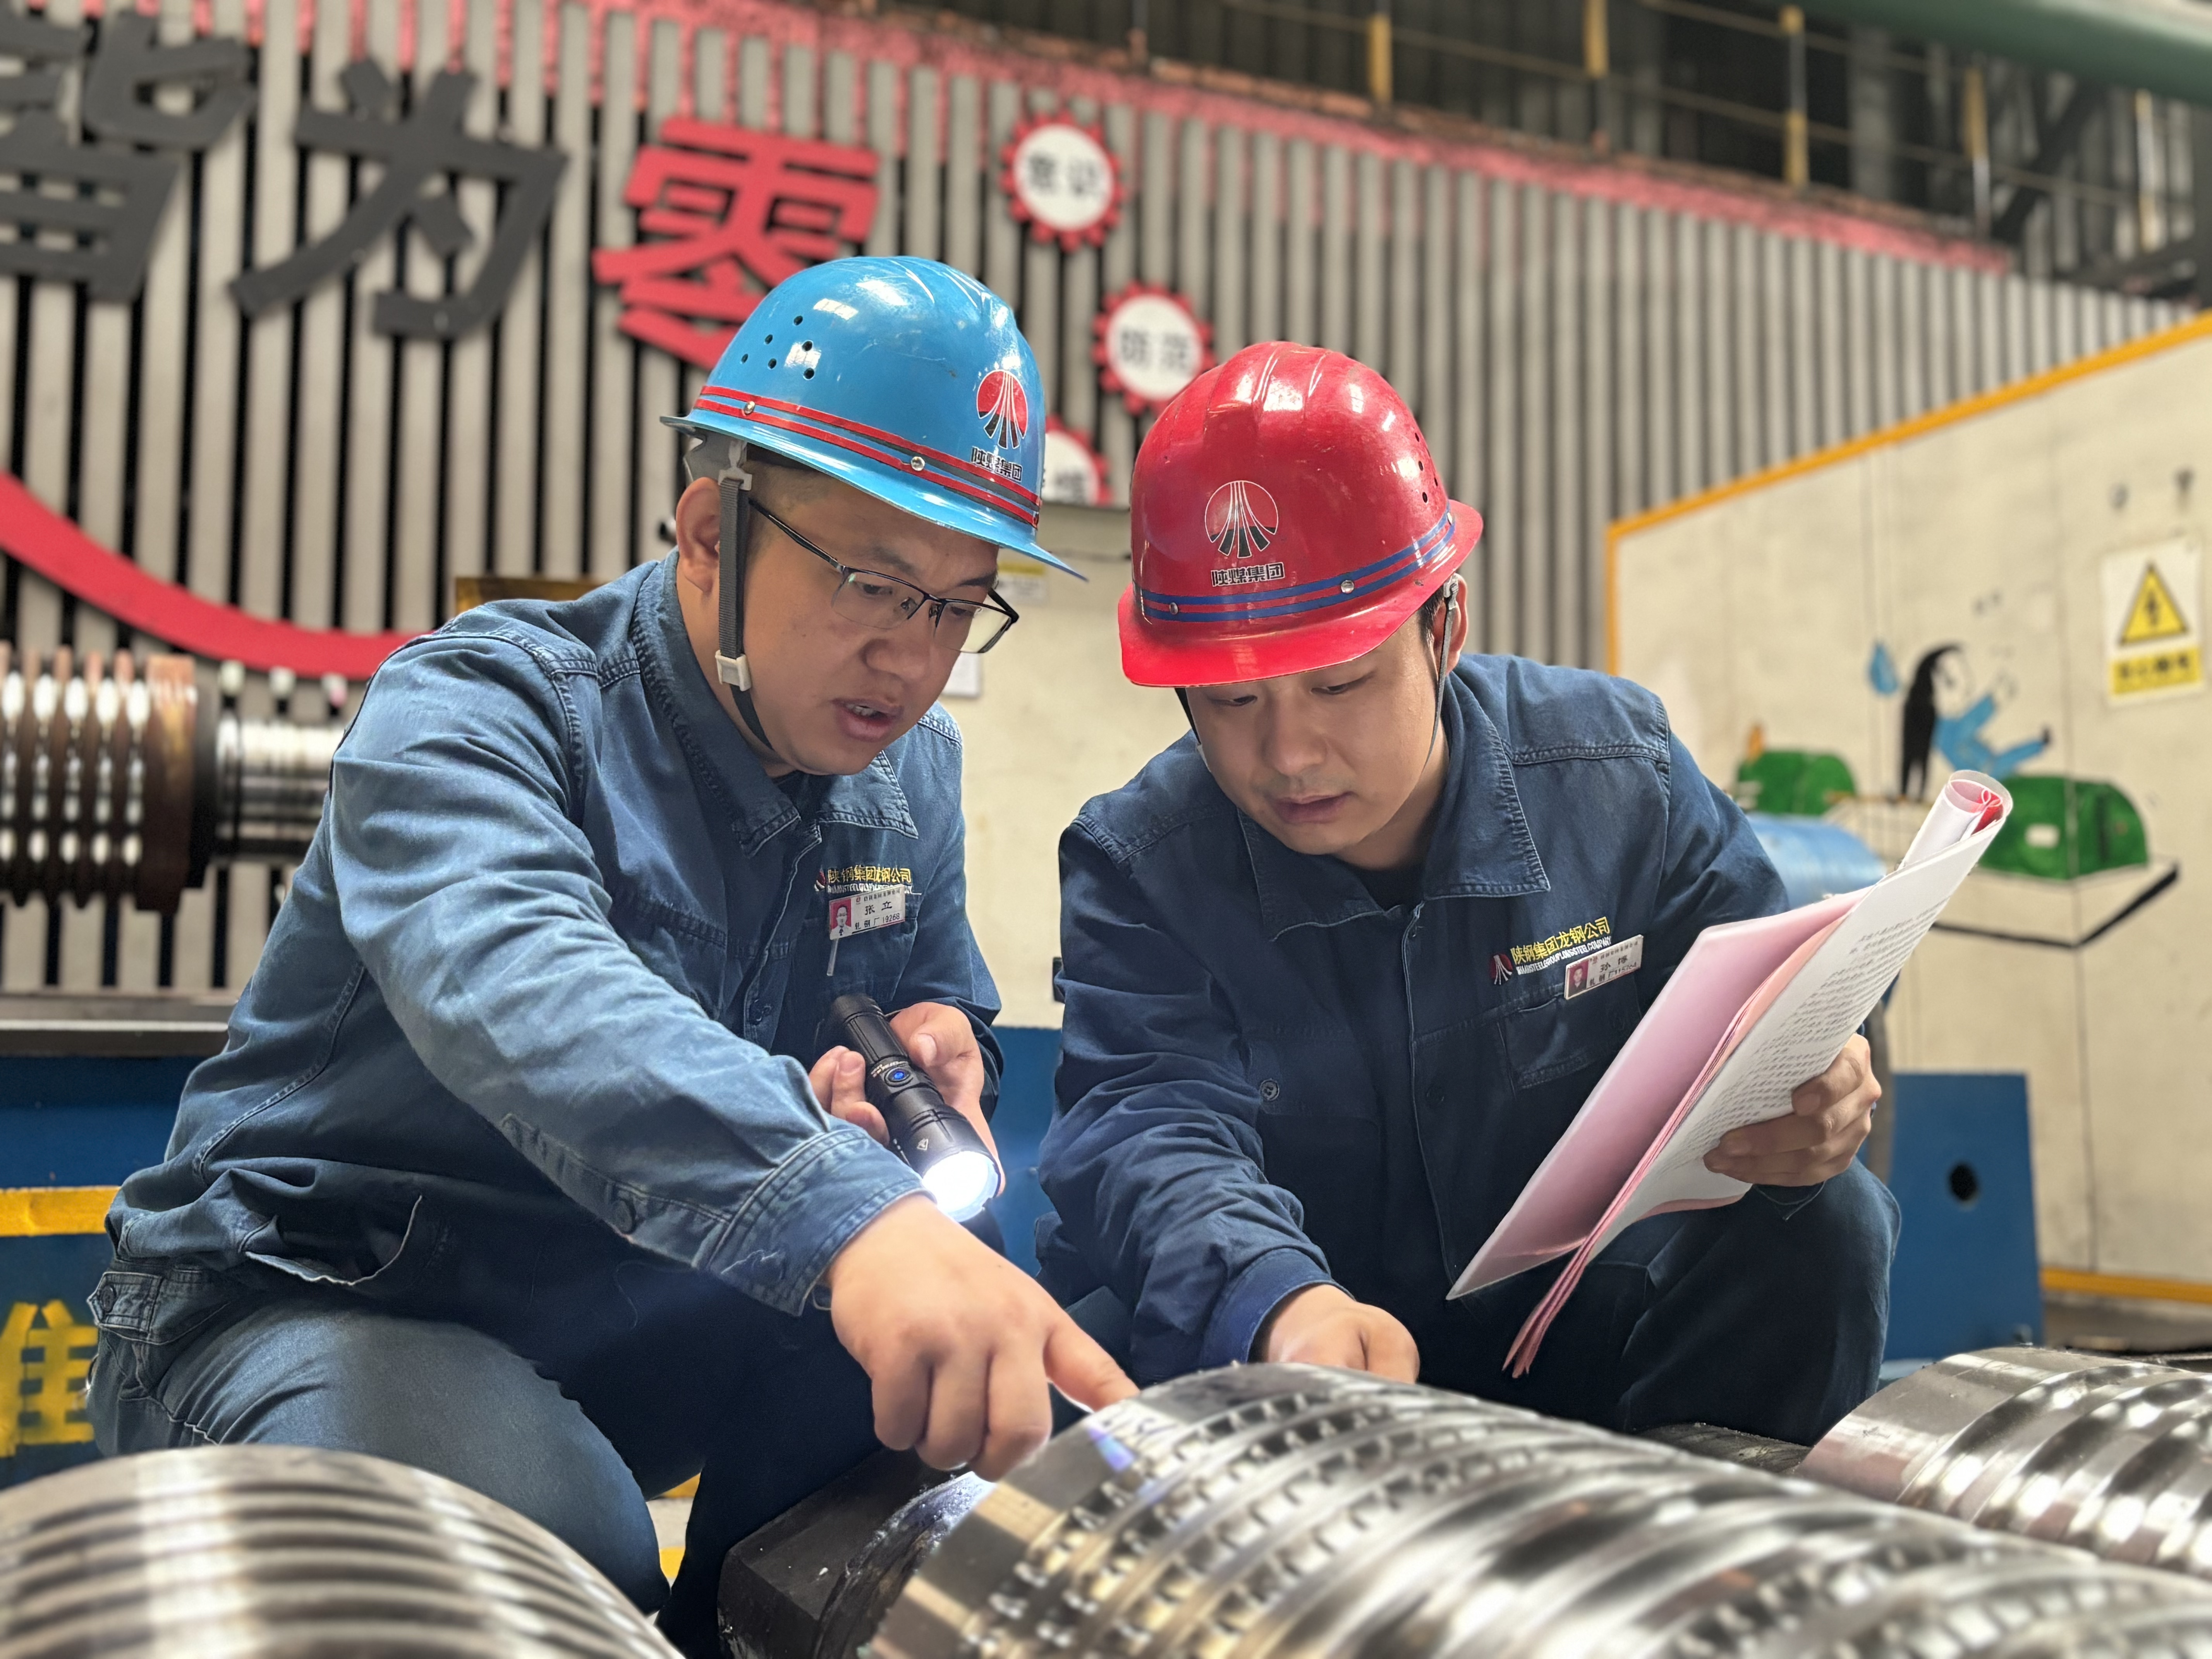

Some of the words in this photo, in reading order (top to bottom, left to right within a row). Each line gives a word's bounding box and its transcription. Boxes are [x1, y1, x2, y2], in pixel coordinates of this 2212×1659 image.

[1211, 562, 1285, 586] 陕煤集团
[1511, 916, 1610, 965] 陕钢集团龙钢公司
